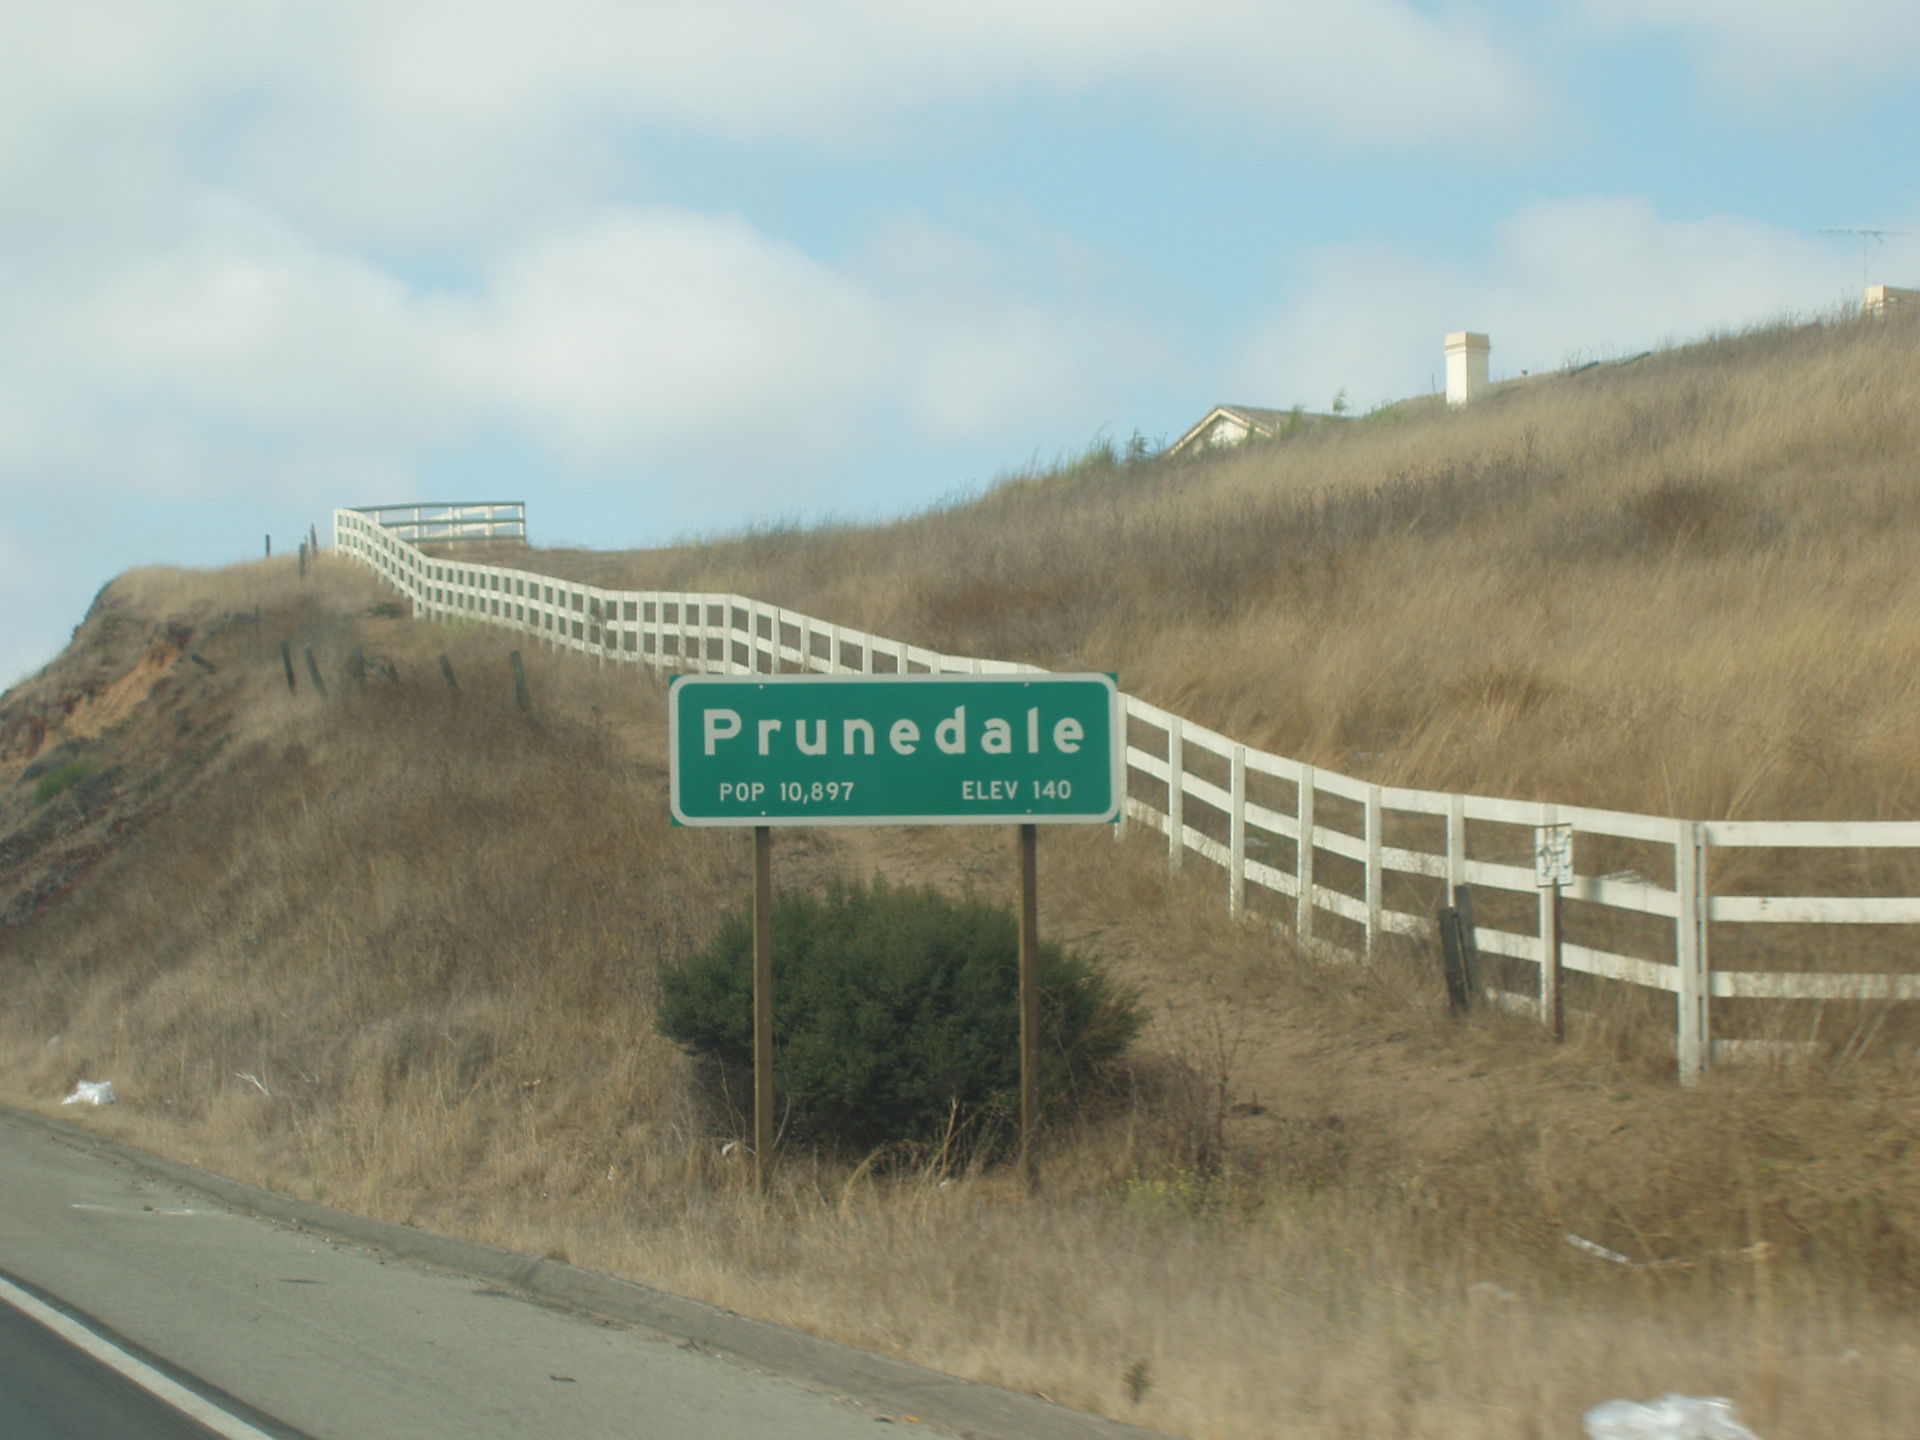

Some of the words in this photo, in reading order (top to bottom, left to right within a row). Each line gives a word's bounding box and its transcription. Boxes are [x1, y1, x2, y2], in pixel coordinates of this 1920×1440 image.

[703, 705, 1086, 756] Prunedale
[718, 782, 766, 802] POP
[779, 781, 855, 804] 10,897
[961, 780, 1019, 800] ELEV
[1032, 779, 1073, 800] 140
